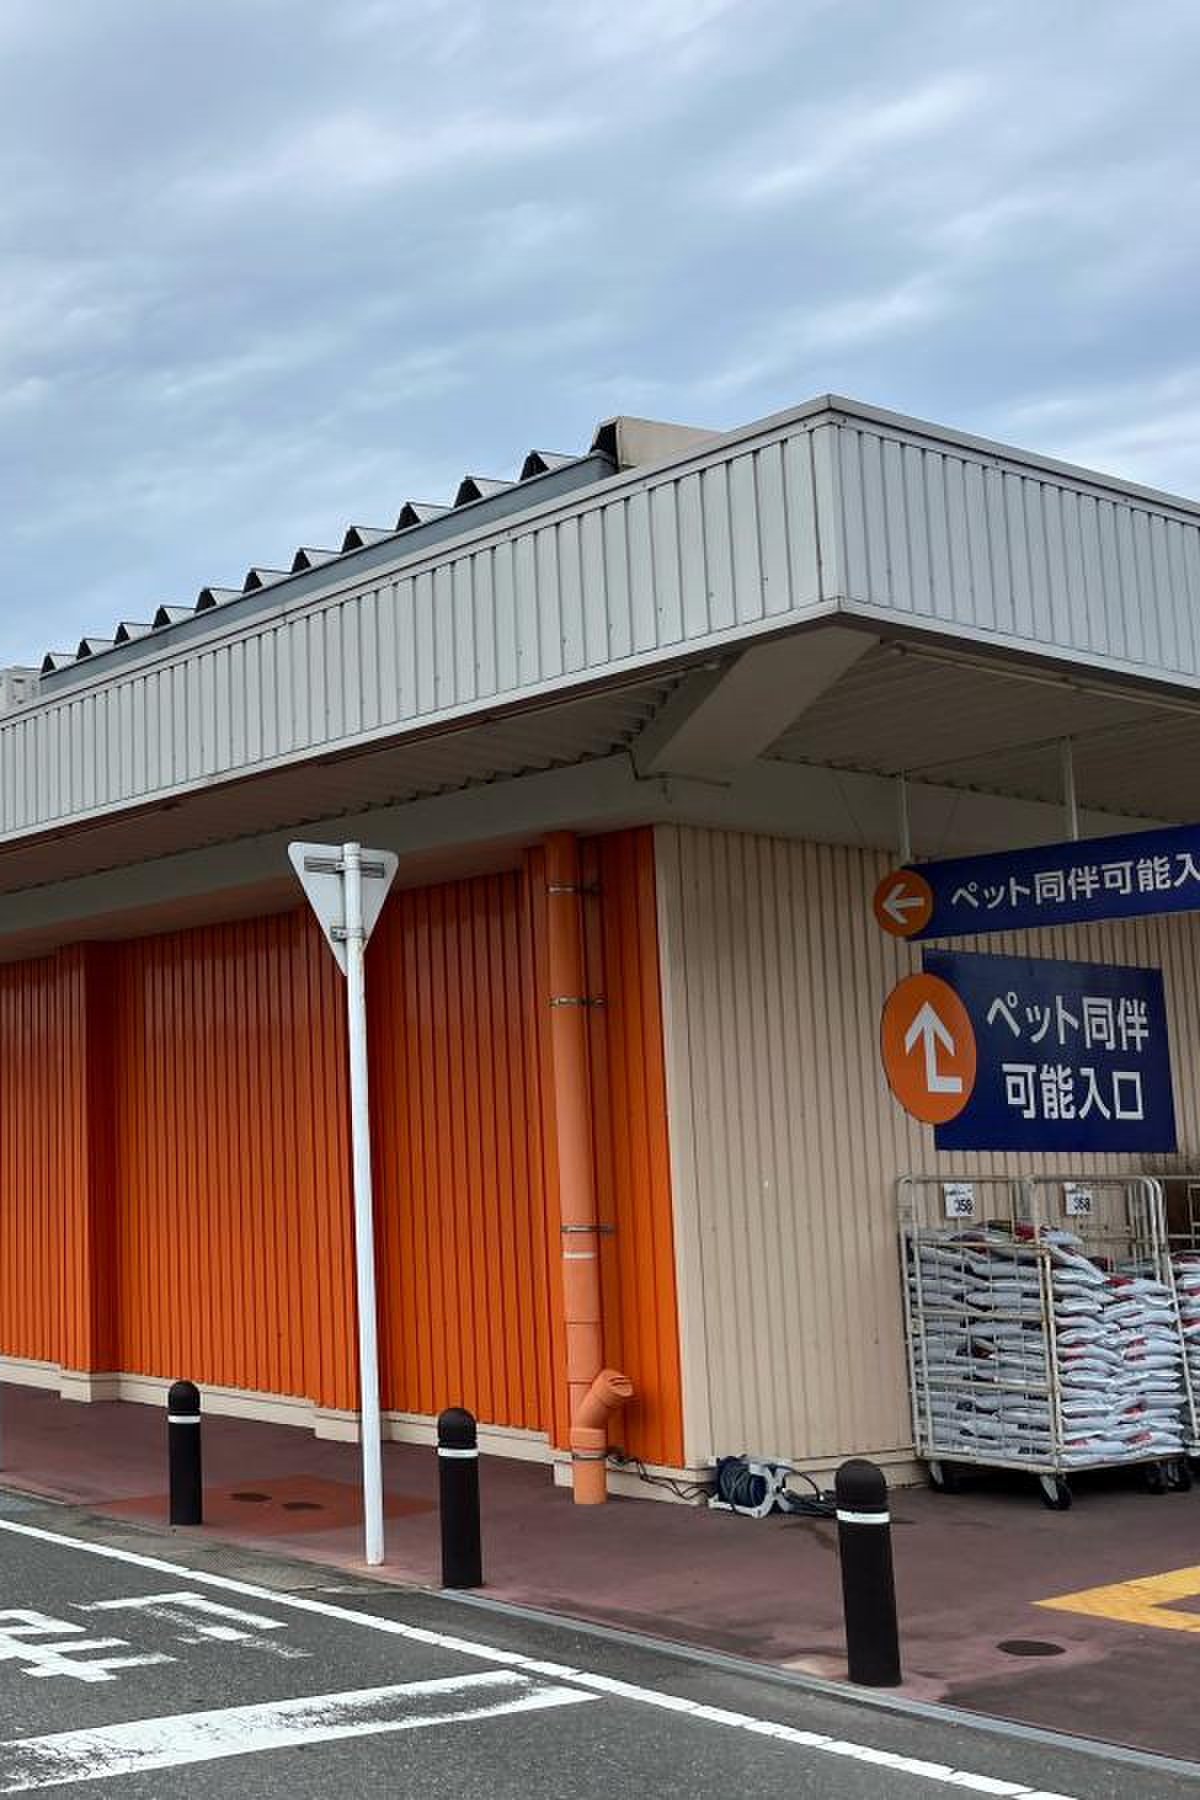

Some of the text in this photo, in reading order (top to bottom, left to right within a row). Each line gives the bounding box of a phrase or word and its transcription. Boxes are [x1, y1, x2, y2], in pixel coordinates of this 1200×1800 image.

[986, 991, 1149, 1051] ペット同伴
[1001, 1063, 1145, 1121] 可能入口
